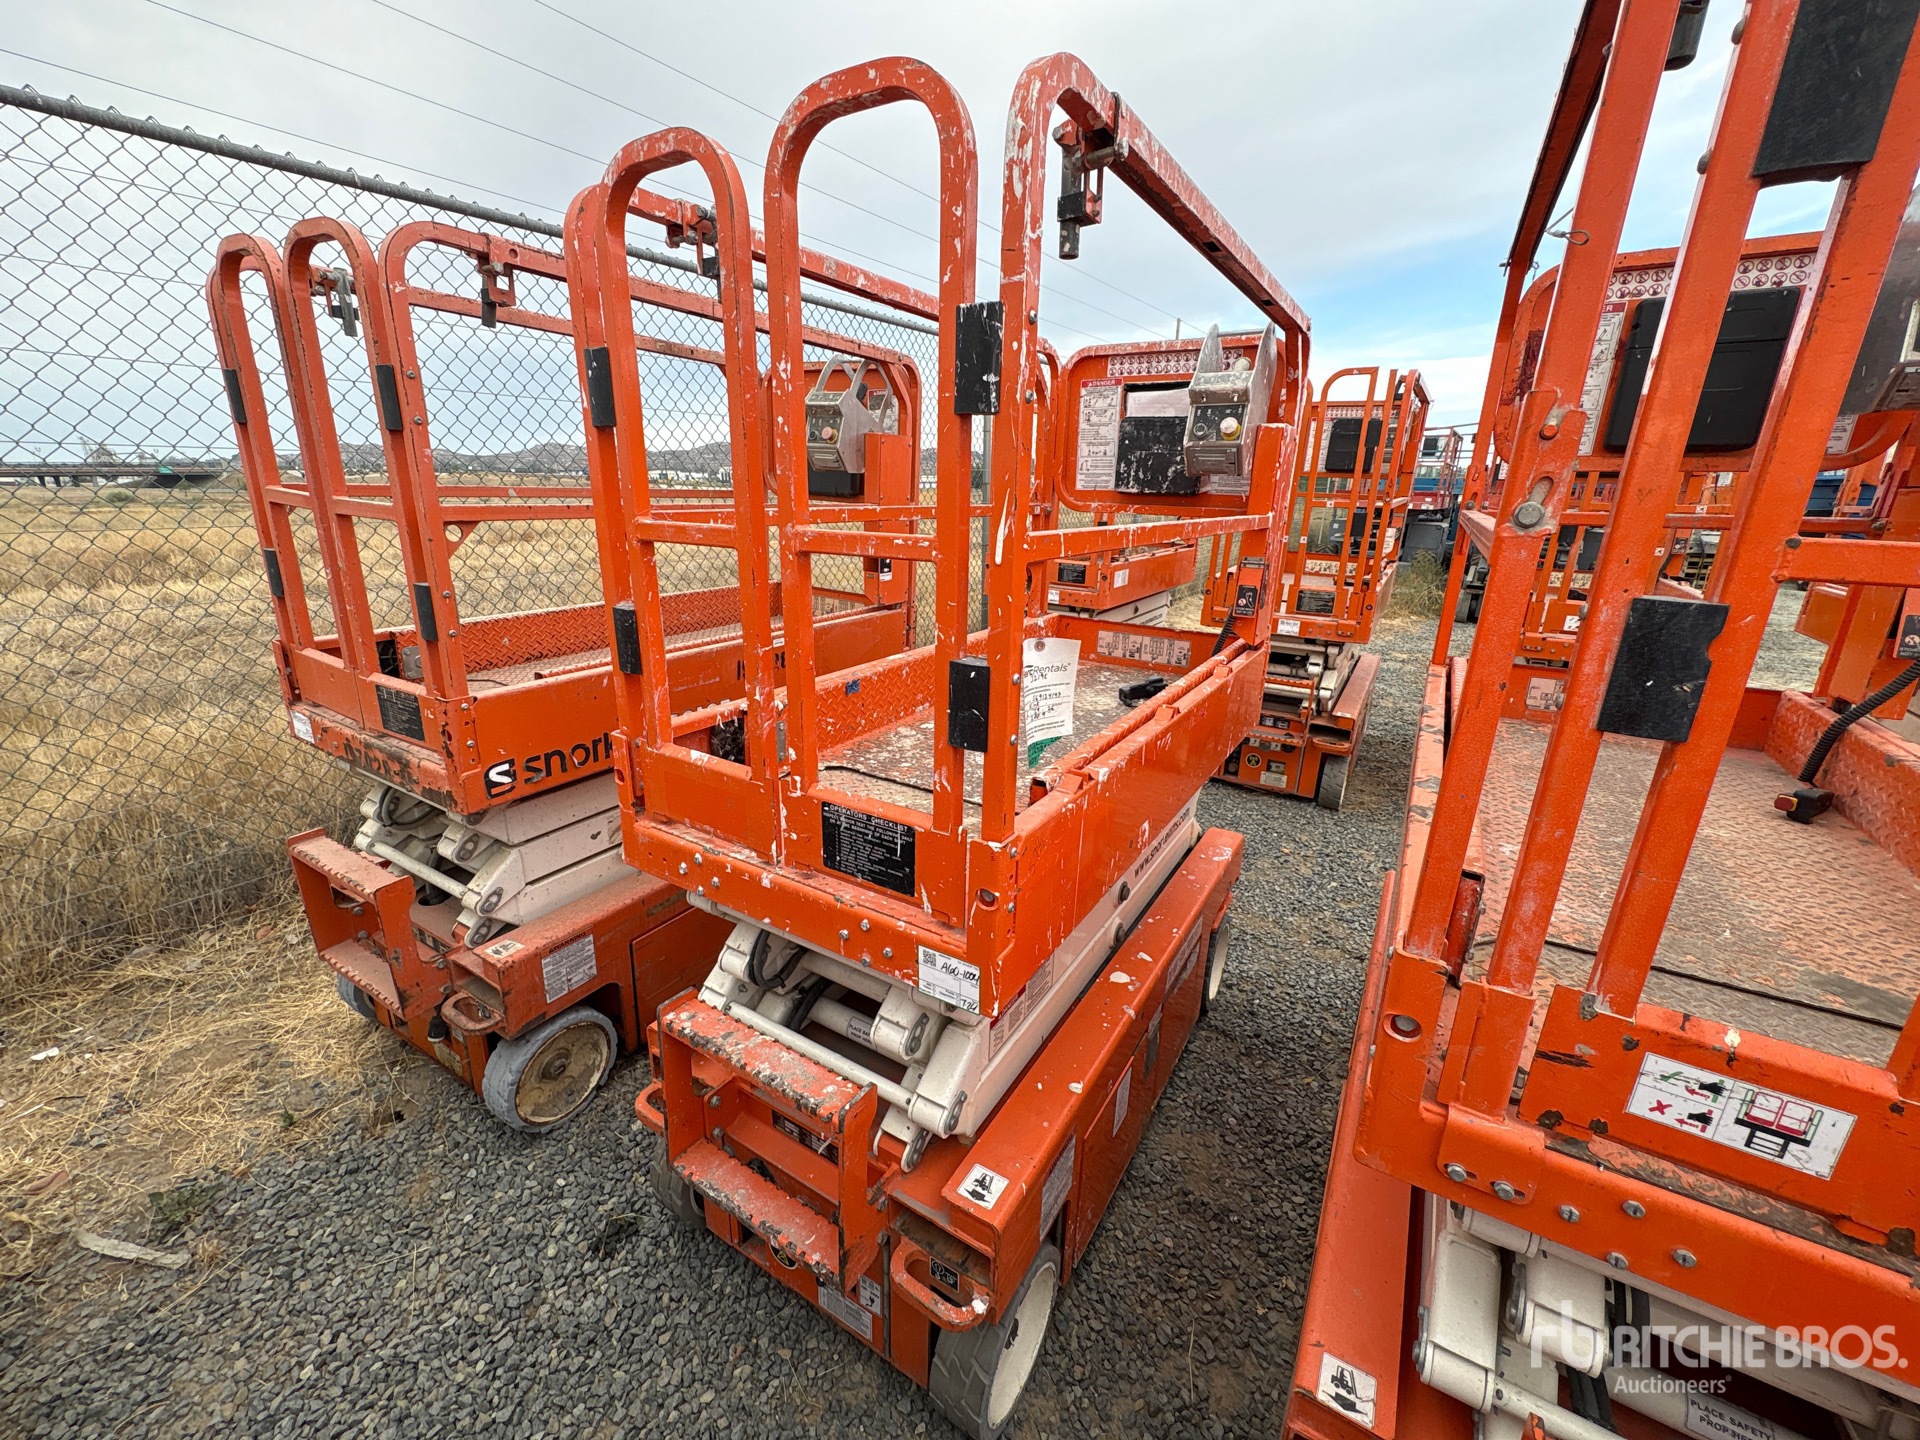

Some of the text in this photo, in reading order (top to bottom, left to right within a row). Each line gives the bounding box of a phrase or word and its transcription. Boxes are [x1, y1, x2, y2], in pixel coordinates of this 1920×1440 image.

[524, 732, 615, 784] snork
[829, 804, 908, 833] OPERATORS CHECKLIST
[1690, 1399, 1771, 1440] PLACE SAFETY
[1700, 1414, 1729, 1434] PROP
